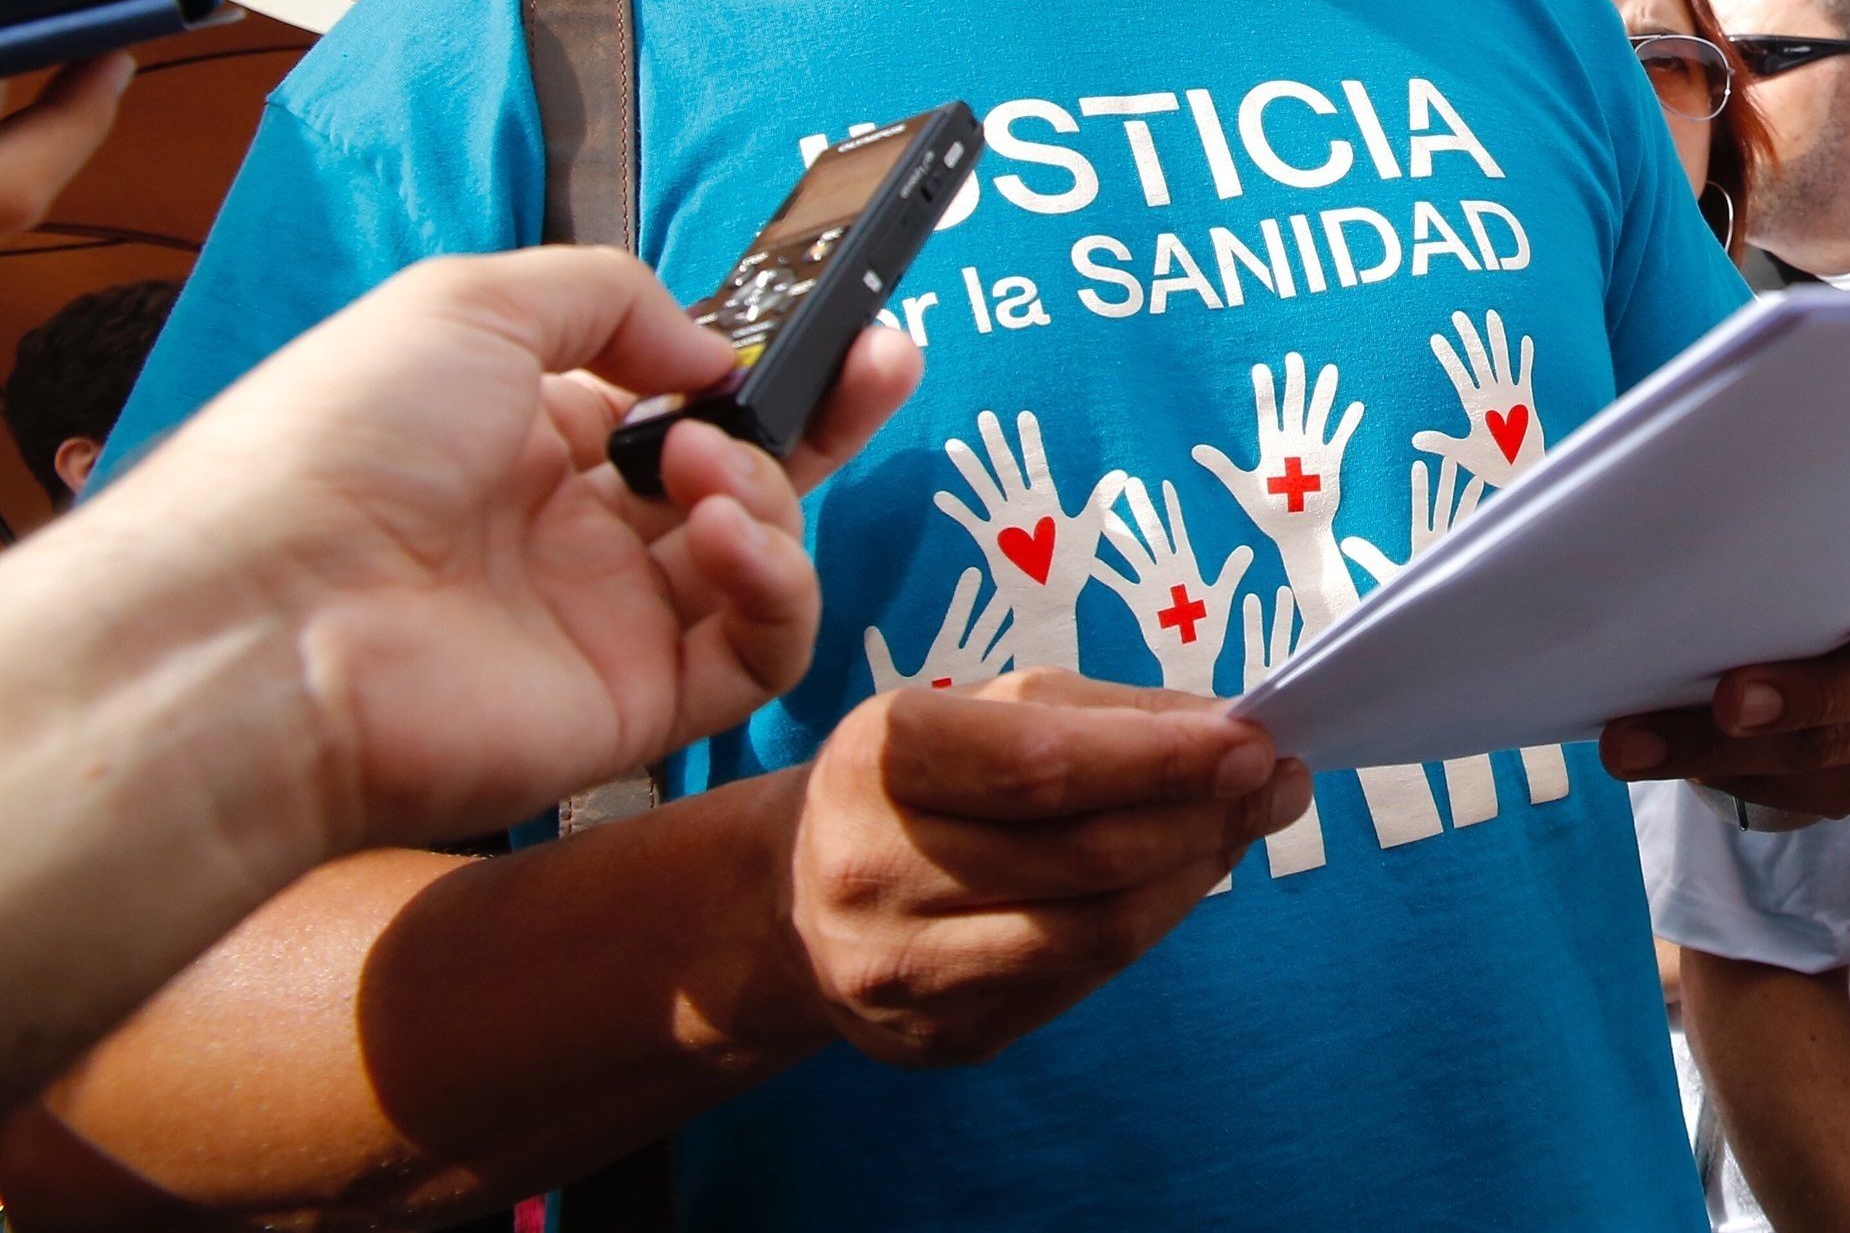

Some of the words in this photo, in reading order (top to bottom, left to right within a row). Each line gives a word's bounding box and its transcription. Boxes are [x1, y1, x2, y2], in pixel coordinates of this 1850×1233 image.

[799, 78, 1506, 233] STICIA
[959, 265, 1051, 334] la
[1070, 200, 1532, 319] SANIDAD
